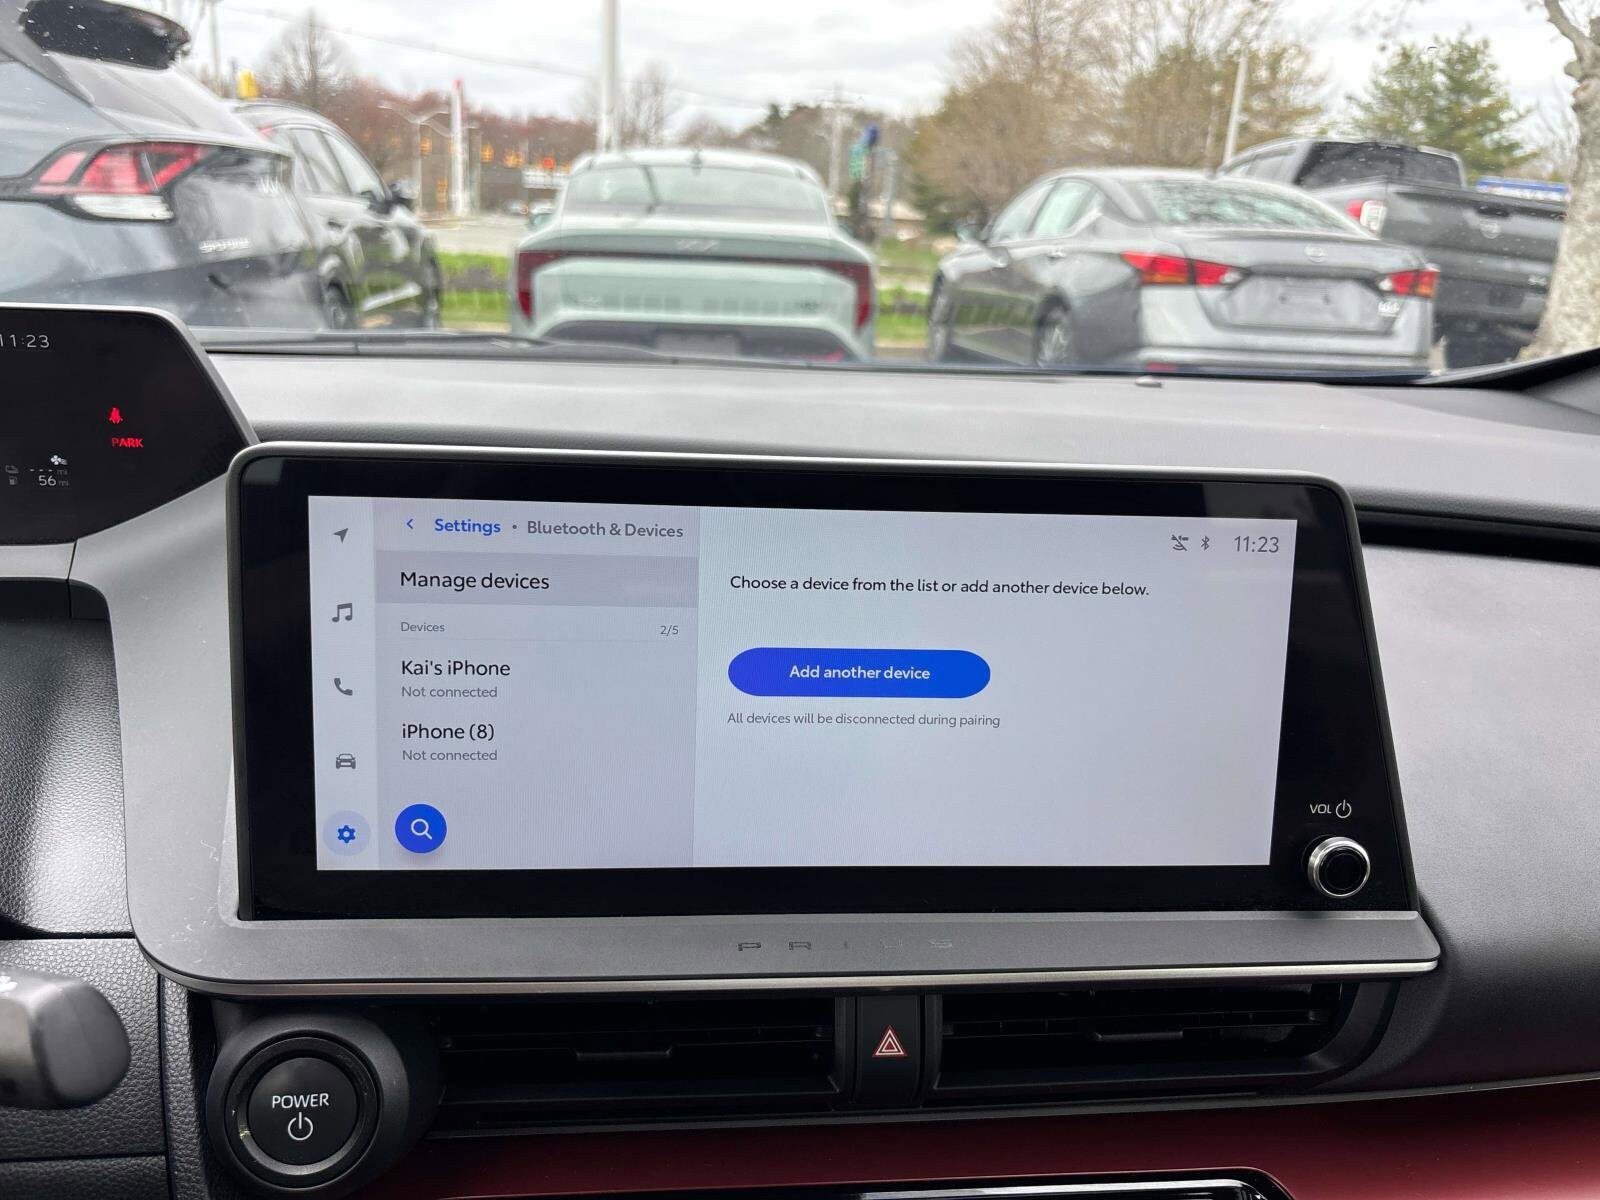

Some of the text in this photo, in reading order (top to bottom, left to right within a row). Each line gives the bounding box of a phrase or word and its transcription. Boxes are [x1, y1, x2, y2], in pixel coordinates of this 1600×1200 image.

[0, 334, 49, 348] 11:23
[112, 437, 144, 448] PARK
[38, 475, 57, 486] 56
[434, 518, 683, 537] Settings Bluetooth & Devices
[1235, 536, 1279, 553] 11:23
[401, 572, 549, 591] Manage devices
[731, 576, 1149, 595] Choose a device from the list or add another device below.
[401, 622, 445, 632] Devices
[660, 625, 678, 636] 2/5
[402, 660, 510, 675] Kai's iPhone
[790, 665, 930, 679] Add another device
[402, 686, 497, 698] Not connected
[728, 713, 1000, 728] All devices will be disconnected during pairing
[403, 724, 494, 741] iPhone (8)
[403, 750, 497, 760] Not connected
[1310, 804, 1331, 813] VOL
[272, 1093, 329, 1108] POWER
